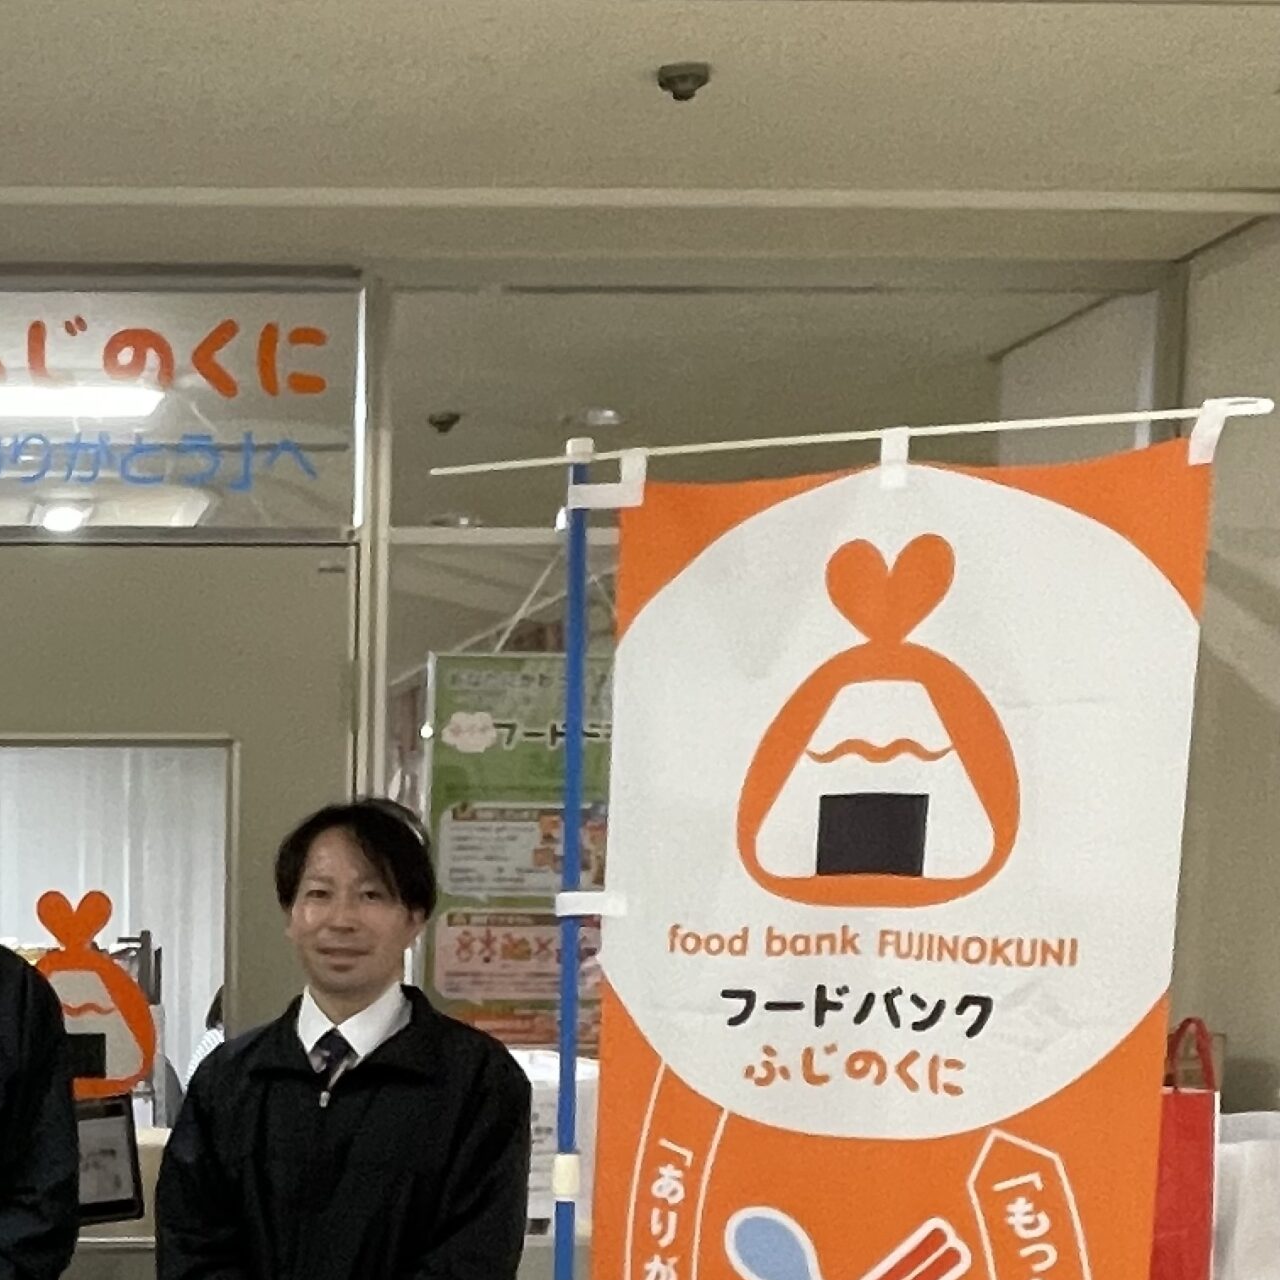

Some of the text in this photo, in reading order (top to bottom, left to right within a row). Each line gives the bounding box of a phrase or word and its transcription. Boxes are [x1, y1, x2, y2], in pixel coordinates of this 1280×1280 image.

[668, 925, 1078, 967] food bank FUJINOKUNI
[720, 984, 993, 1038] フードバンク
[743, 1044, 966, 1096] ふじのくに
